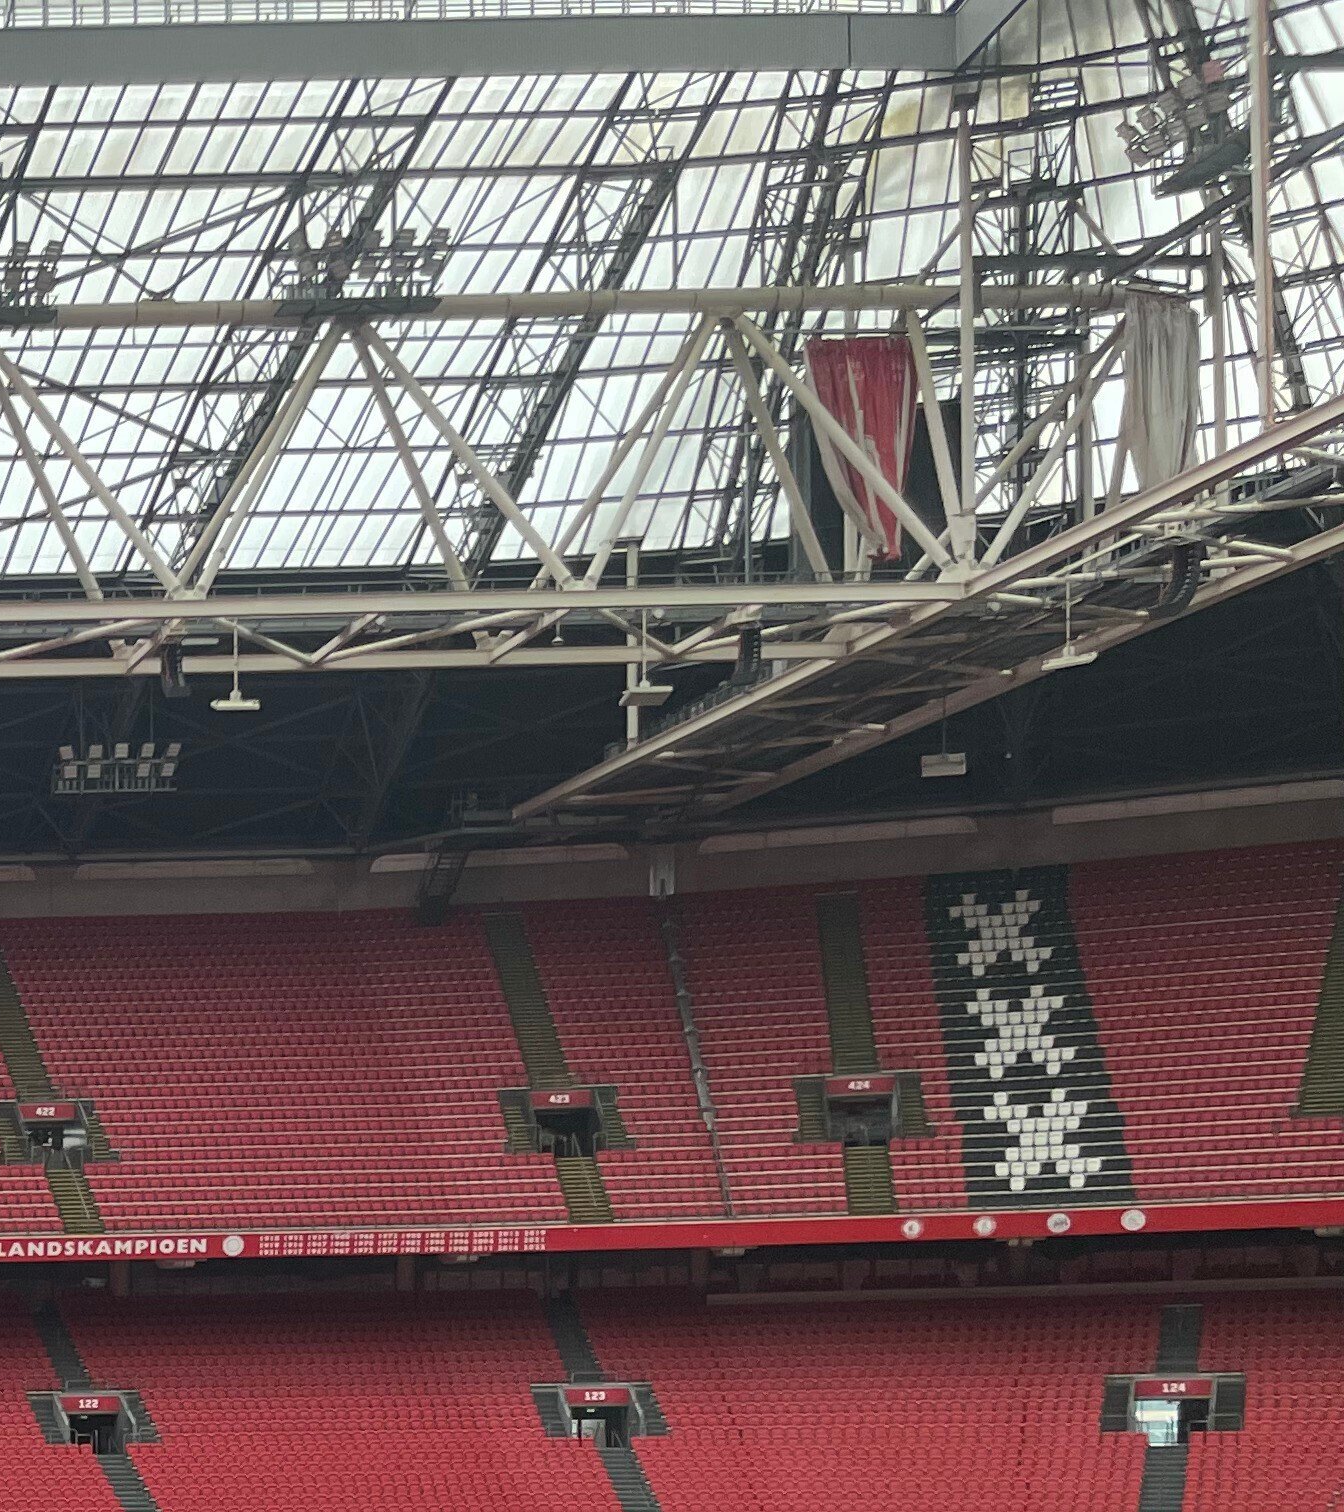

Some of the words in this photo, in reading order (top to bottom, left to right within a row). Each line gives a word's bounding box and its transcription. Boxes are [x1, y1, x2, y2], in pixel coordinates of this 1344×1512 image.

[847, 1080, 870, 1090] 424
[35, 1106, 56, 1117] 422
[1162, 1383, 1187, 1393] 124
[584, 1391, 606, 1401] 123
[78, 1399, 99, 1409] 122
